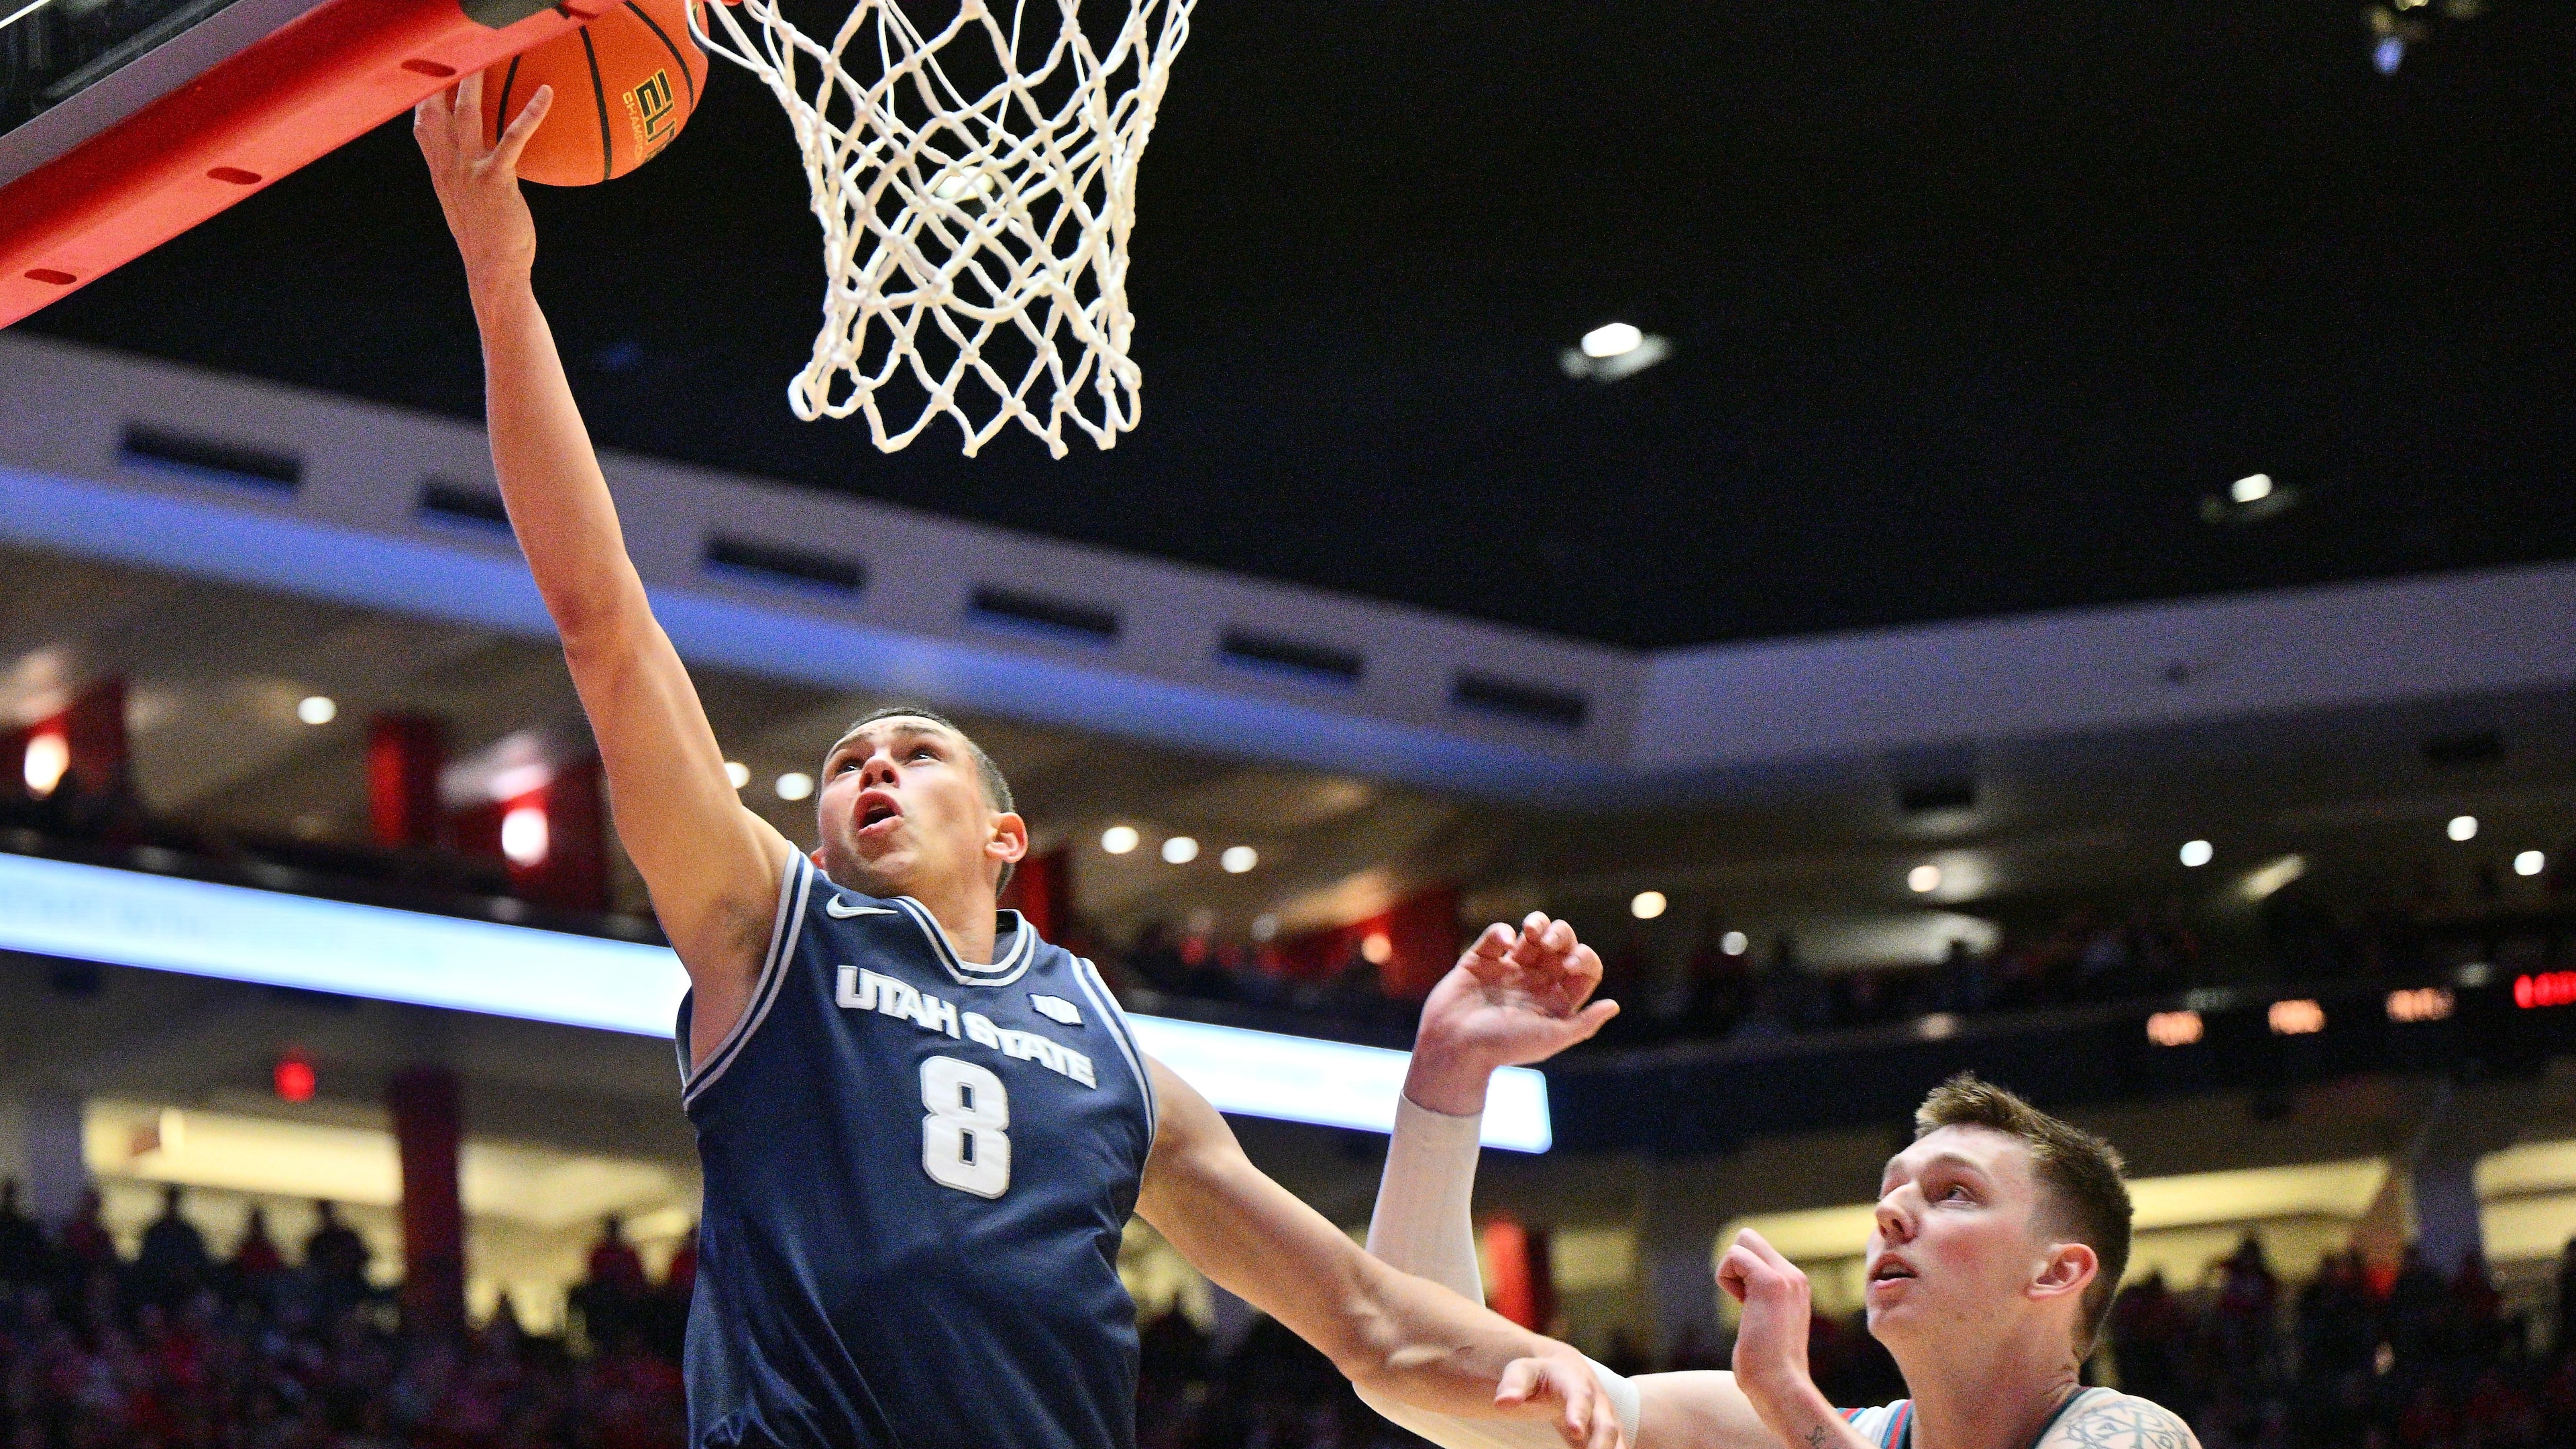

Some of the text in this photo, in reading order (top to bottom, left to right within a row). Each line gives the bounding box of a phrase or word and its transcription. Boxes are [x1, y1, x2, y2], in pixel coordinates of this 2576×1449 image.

[835, 965, 961, 1040] UTAH
[961, 1011, 1097, 1089] STATE
[920, 1055, 1012, 1199] 8
